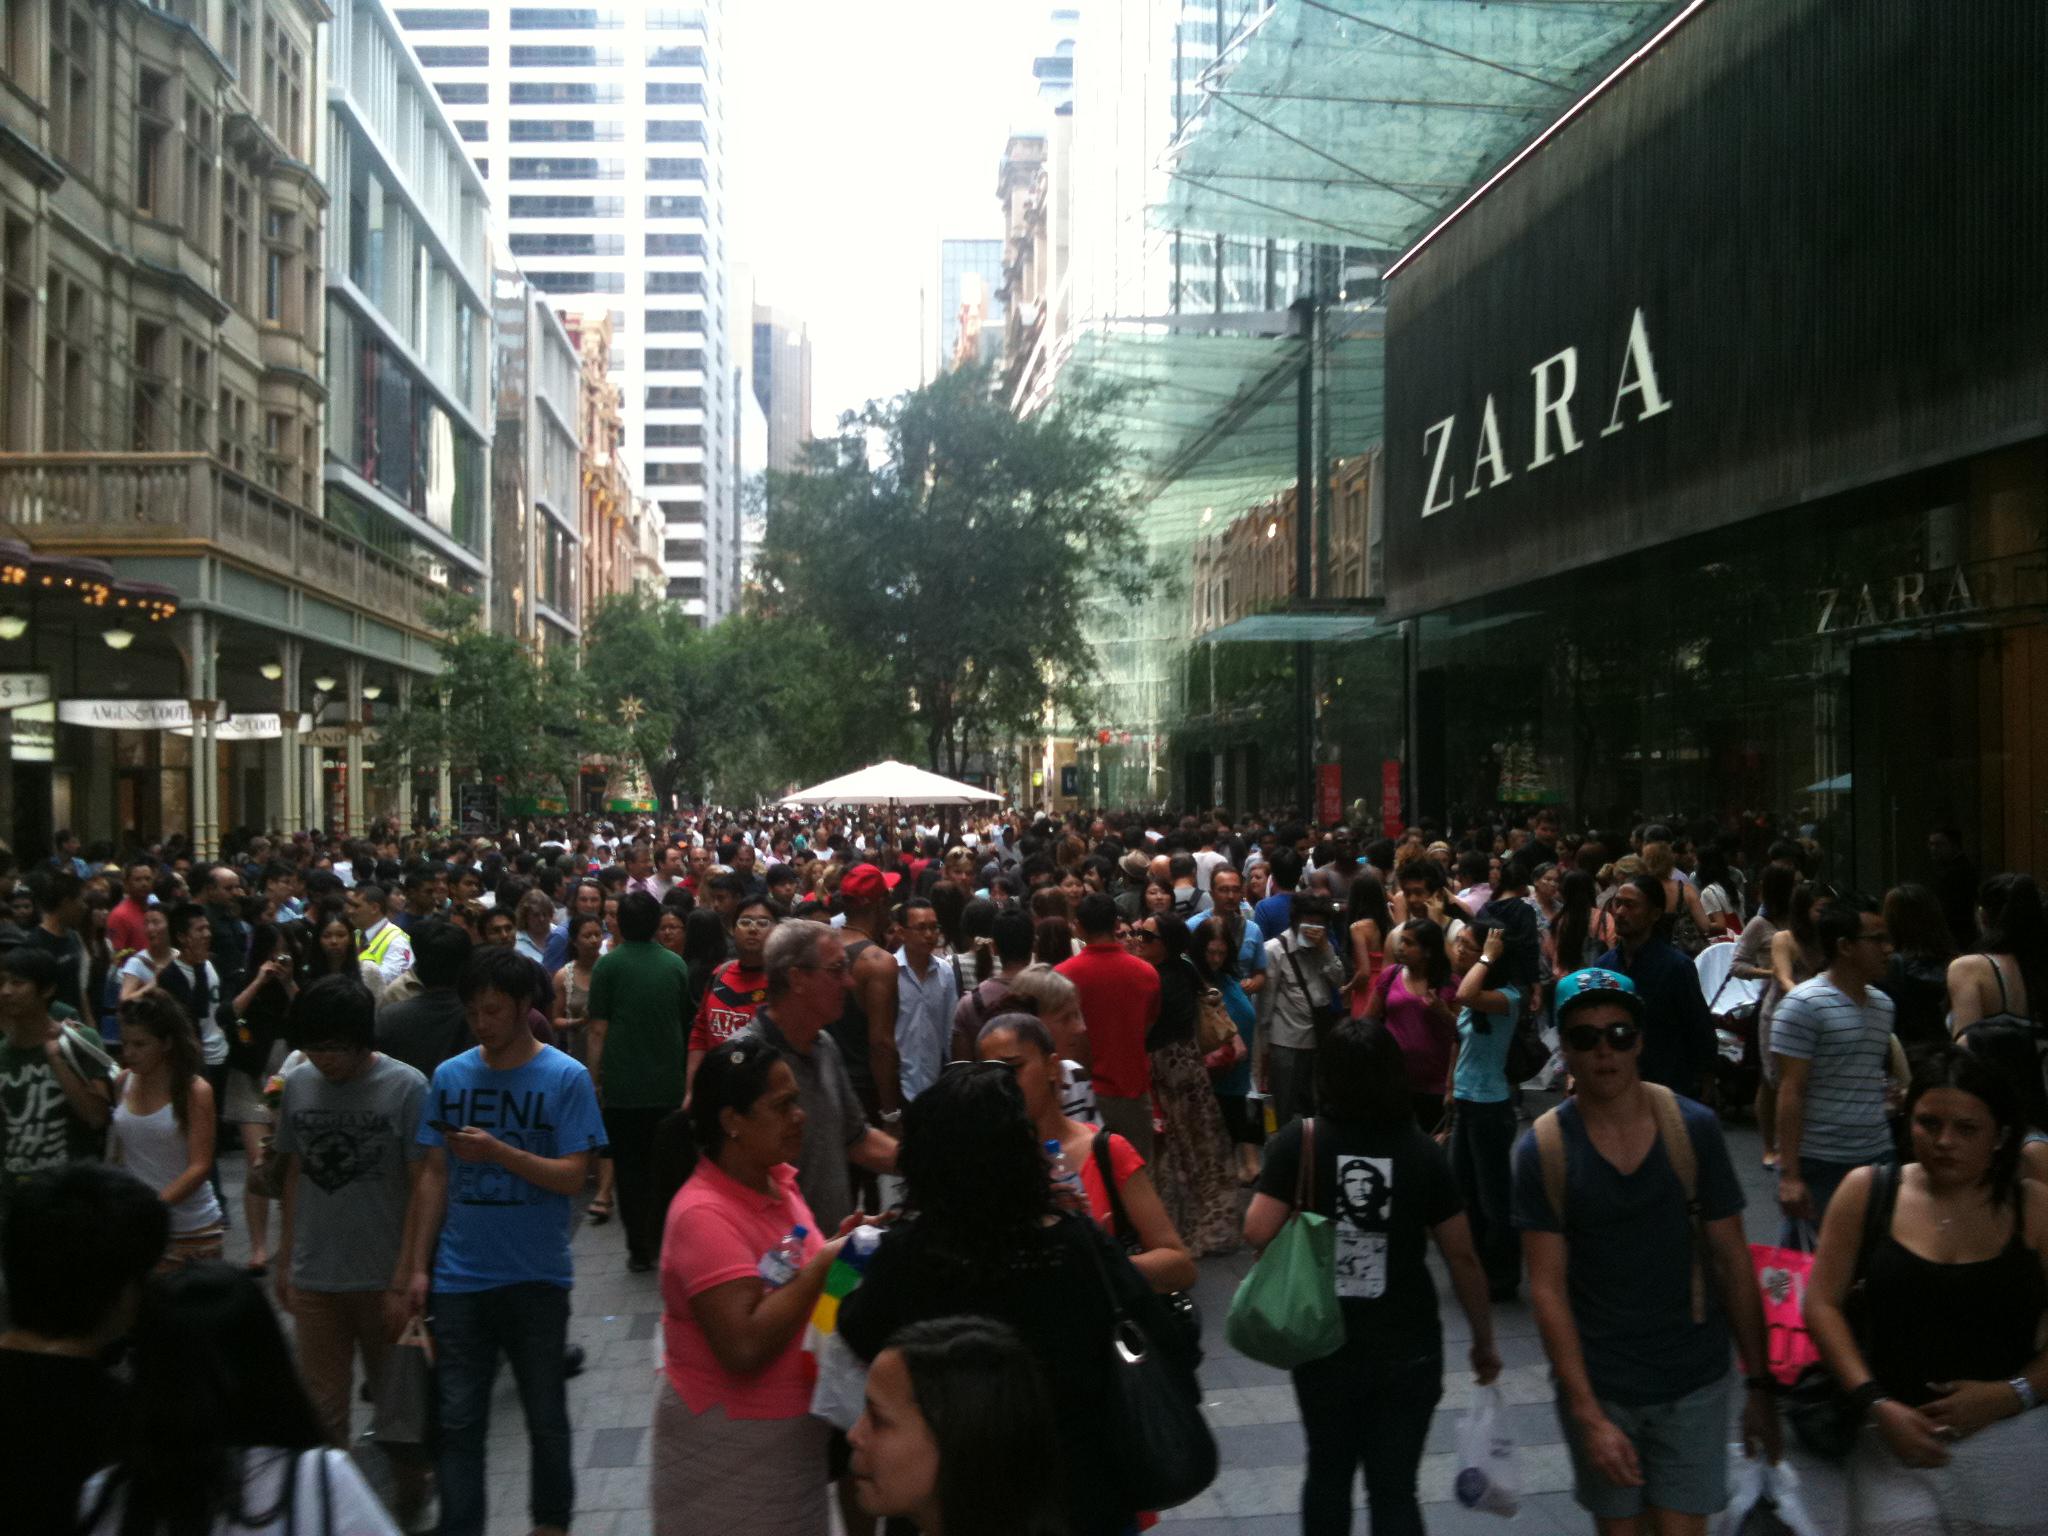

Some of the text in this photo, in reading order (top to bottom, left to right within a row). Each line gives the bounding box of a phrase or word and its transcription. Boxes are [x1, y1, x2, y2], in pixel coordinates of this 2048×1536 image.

[1421, 306, 1672, 518] ZARA
[1816, 563, 1981, 633] ZARA
[306, 731, 376, 745] PANDA
[439, 1088, 554, 1131] HENL
